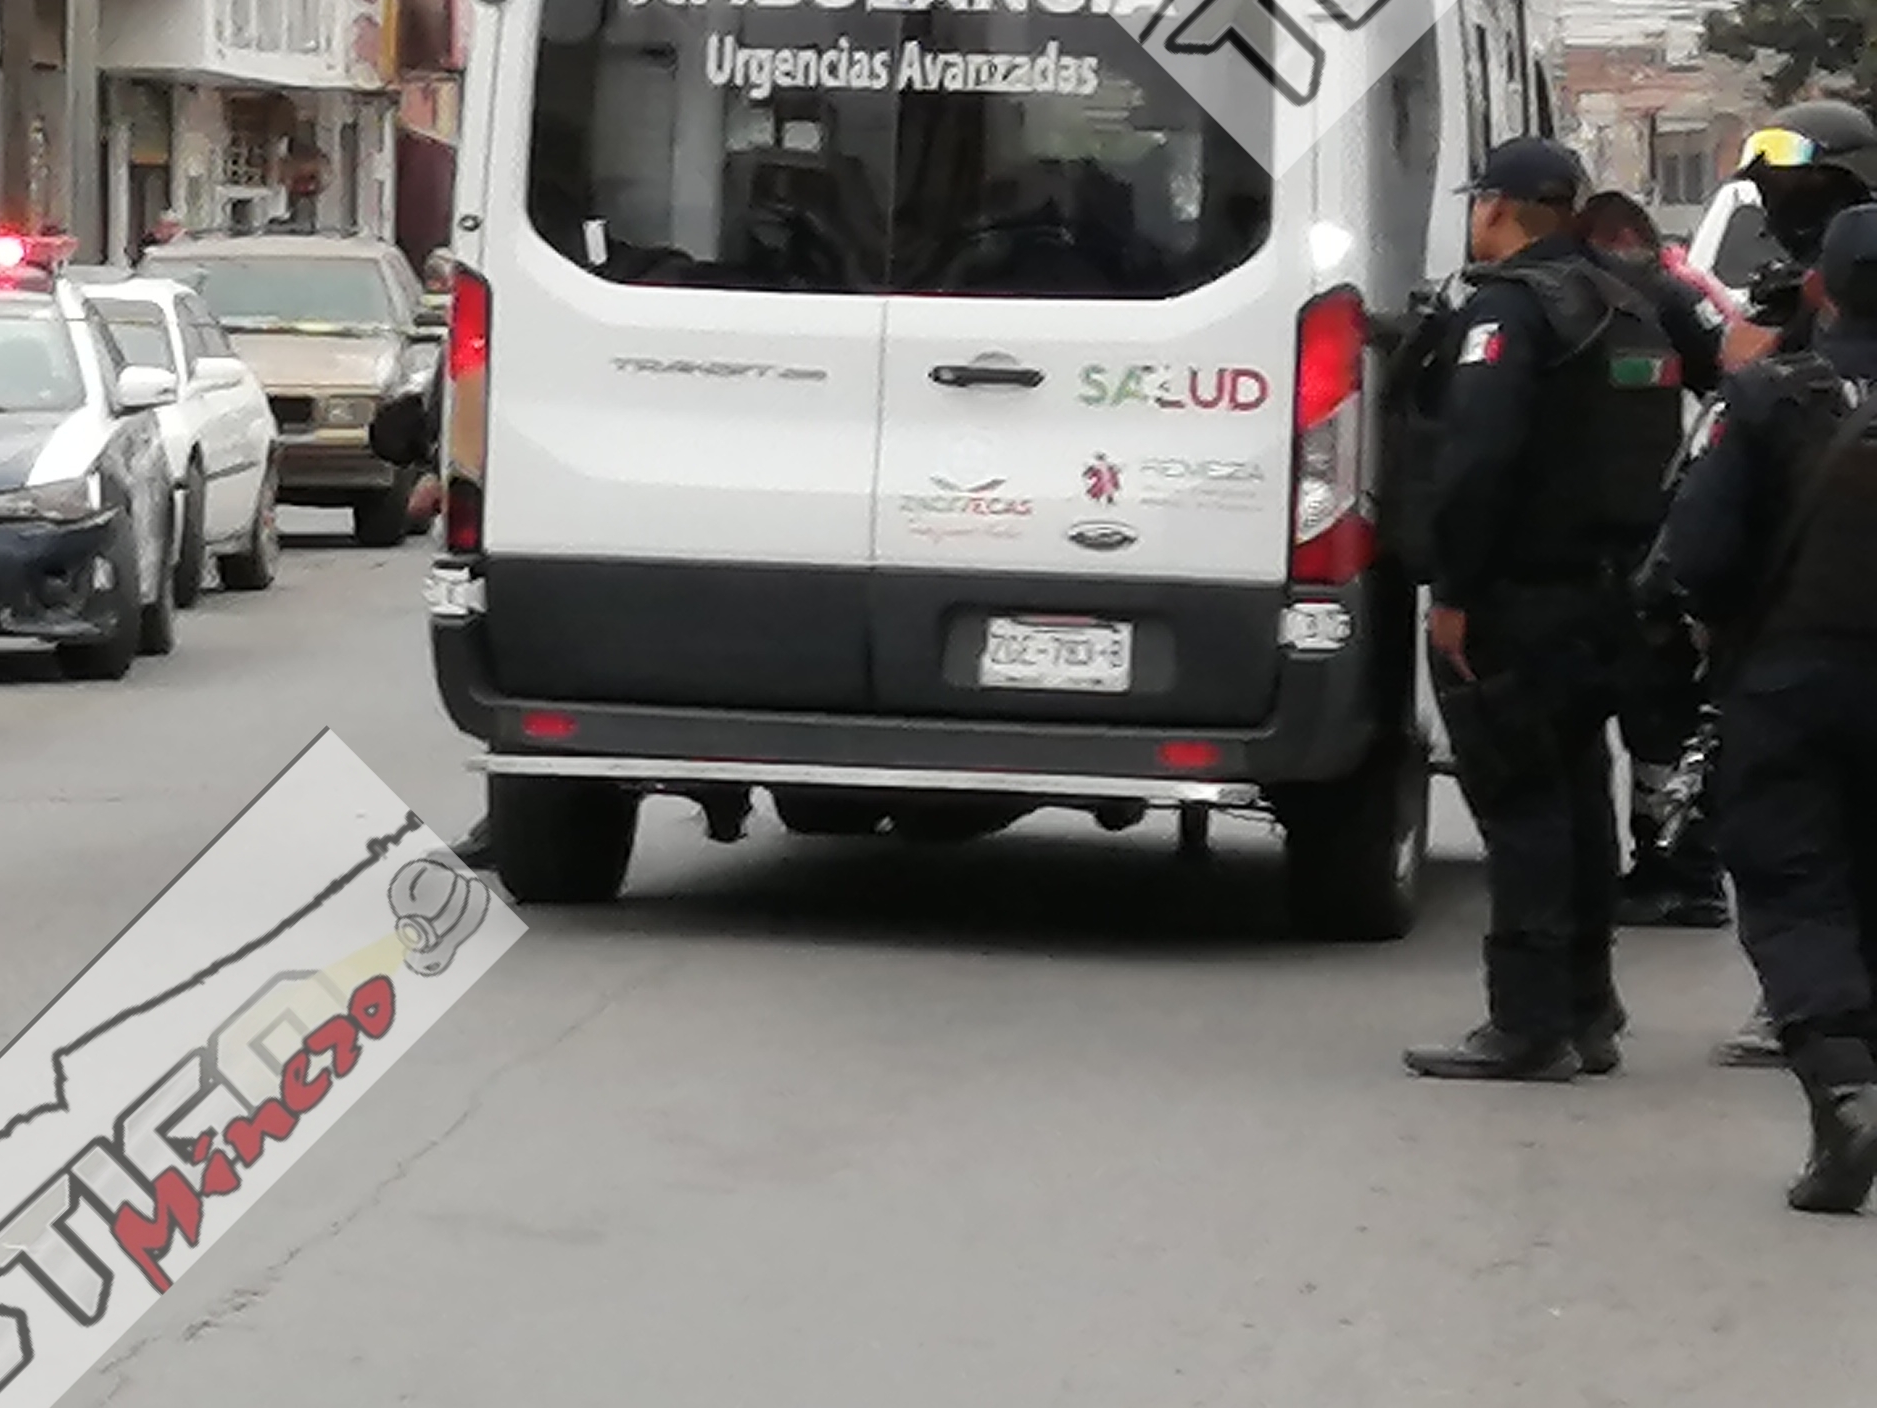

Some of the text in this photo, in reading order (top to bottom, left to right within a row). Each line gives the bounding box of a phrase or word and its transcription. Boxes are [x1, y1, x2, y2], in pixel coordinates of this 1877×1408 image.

[705, 32, 1100, 100] Urgencias Avanzadas
[1077, 364, 1270, 411] SALUD
